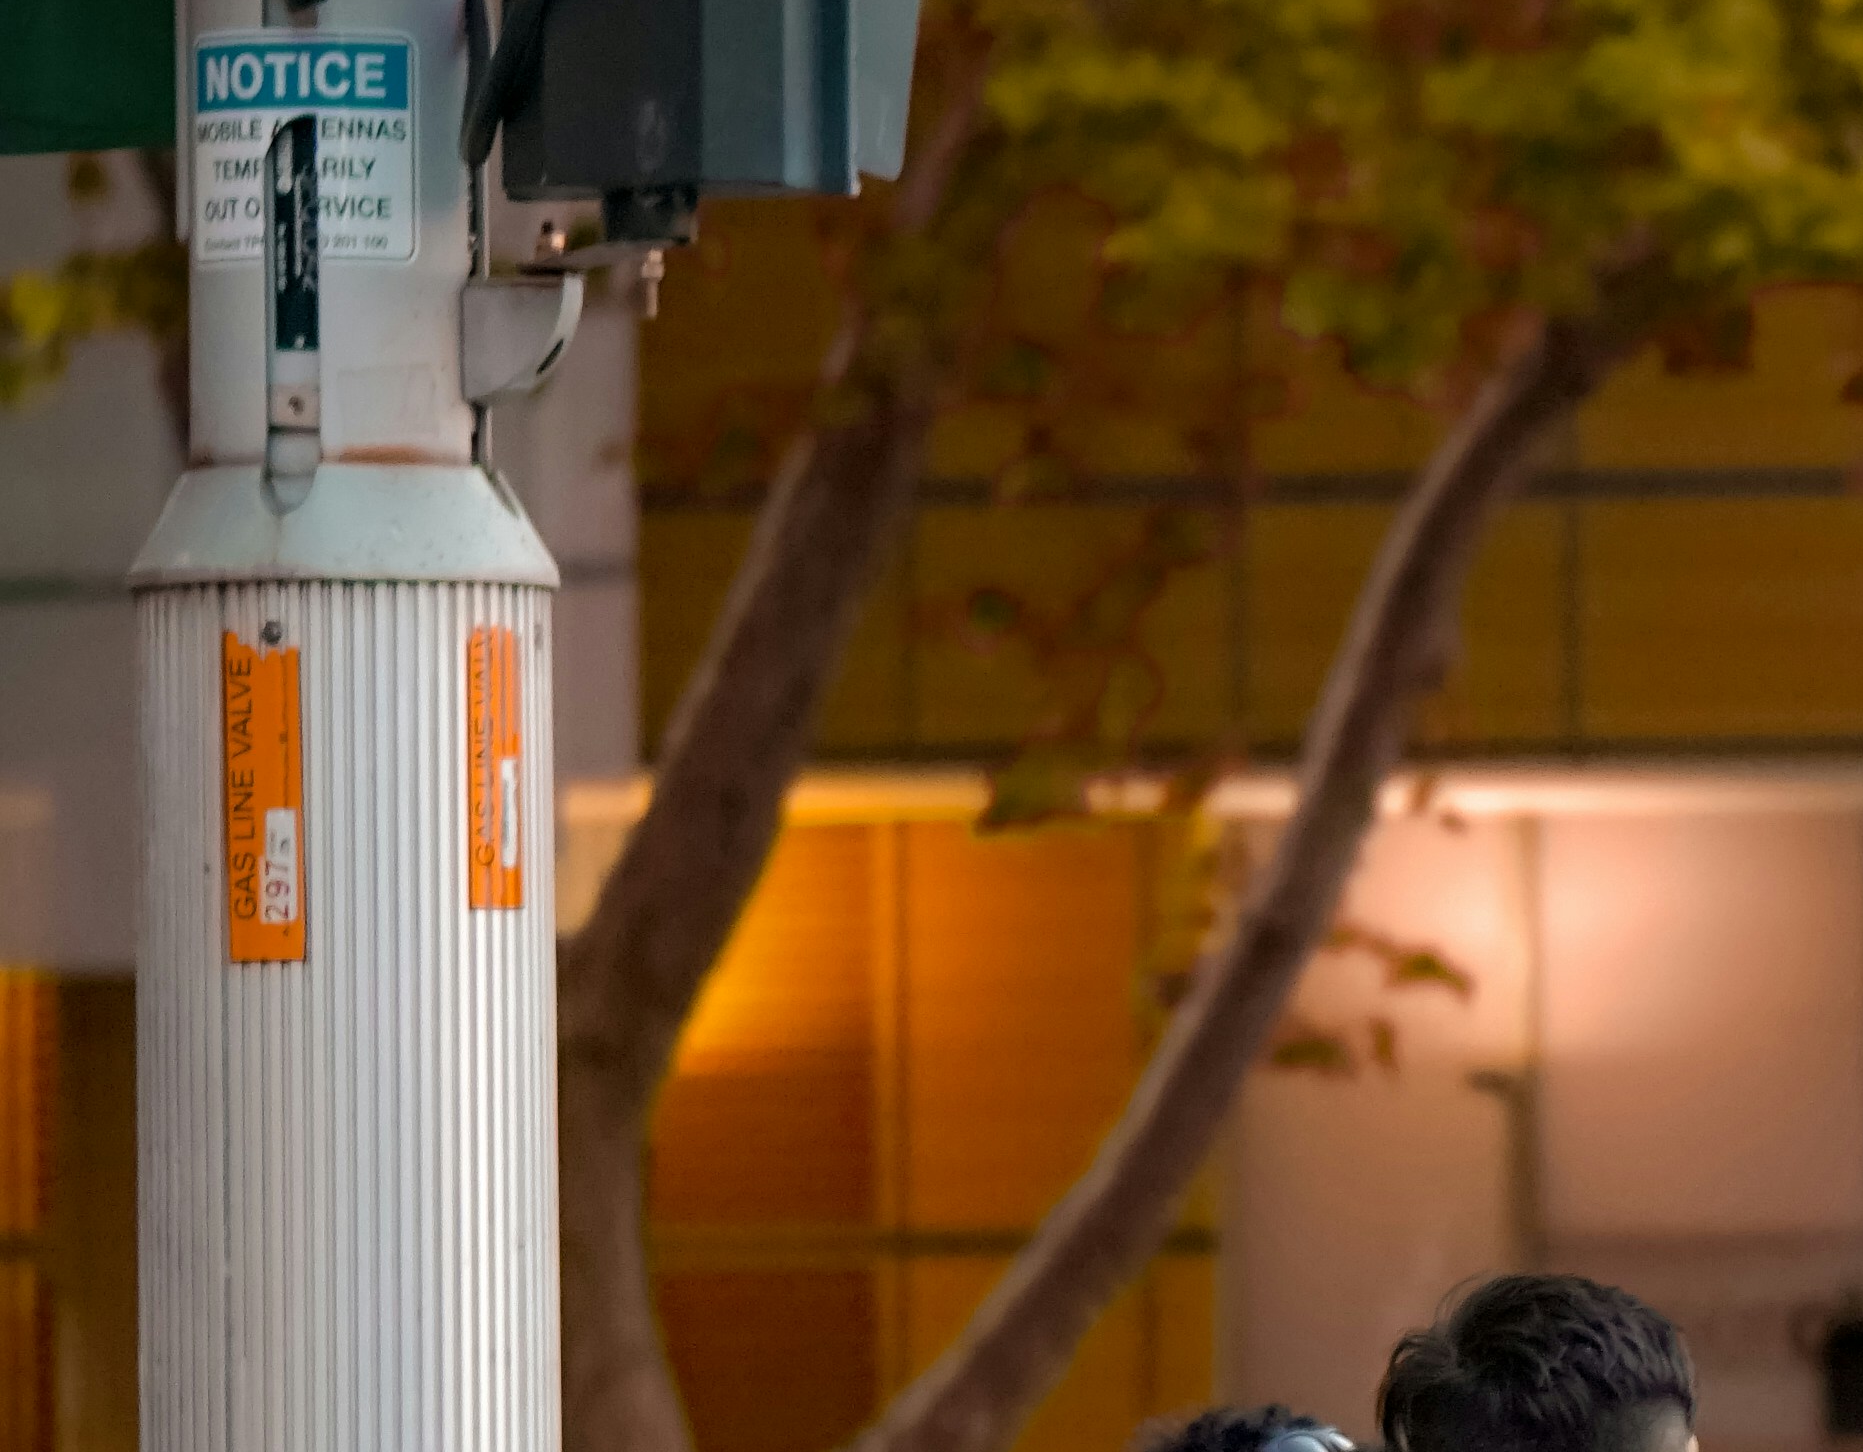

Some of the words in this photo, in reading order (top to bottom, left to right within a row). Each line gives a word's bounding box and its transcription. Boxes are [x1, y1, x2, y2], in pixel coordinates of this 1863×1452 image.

[206, 51, 386, 103] NOTICE
[213, 157, 375, 182] TEMPRILY
[204, 199, 239, 222] OUT
[229, 656, 253, 760] VALVE
[231, 768, 255, 840] LINE
[233, 851, 258, 920] GAS
